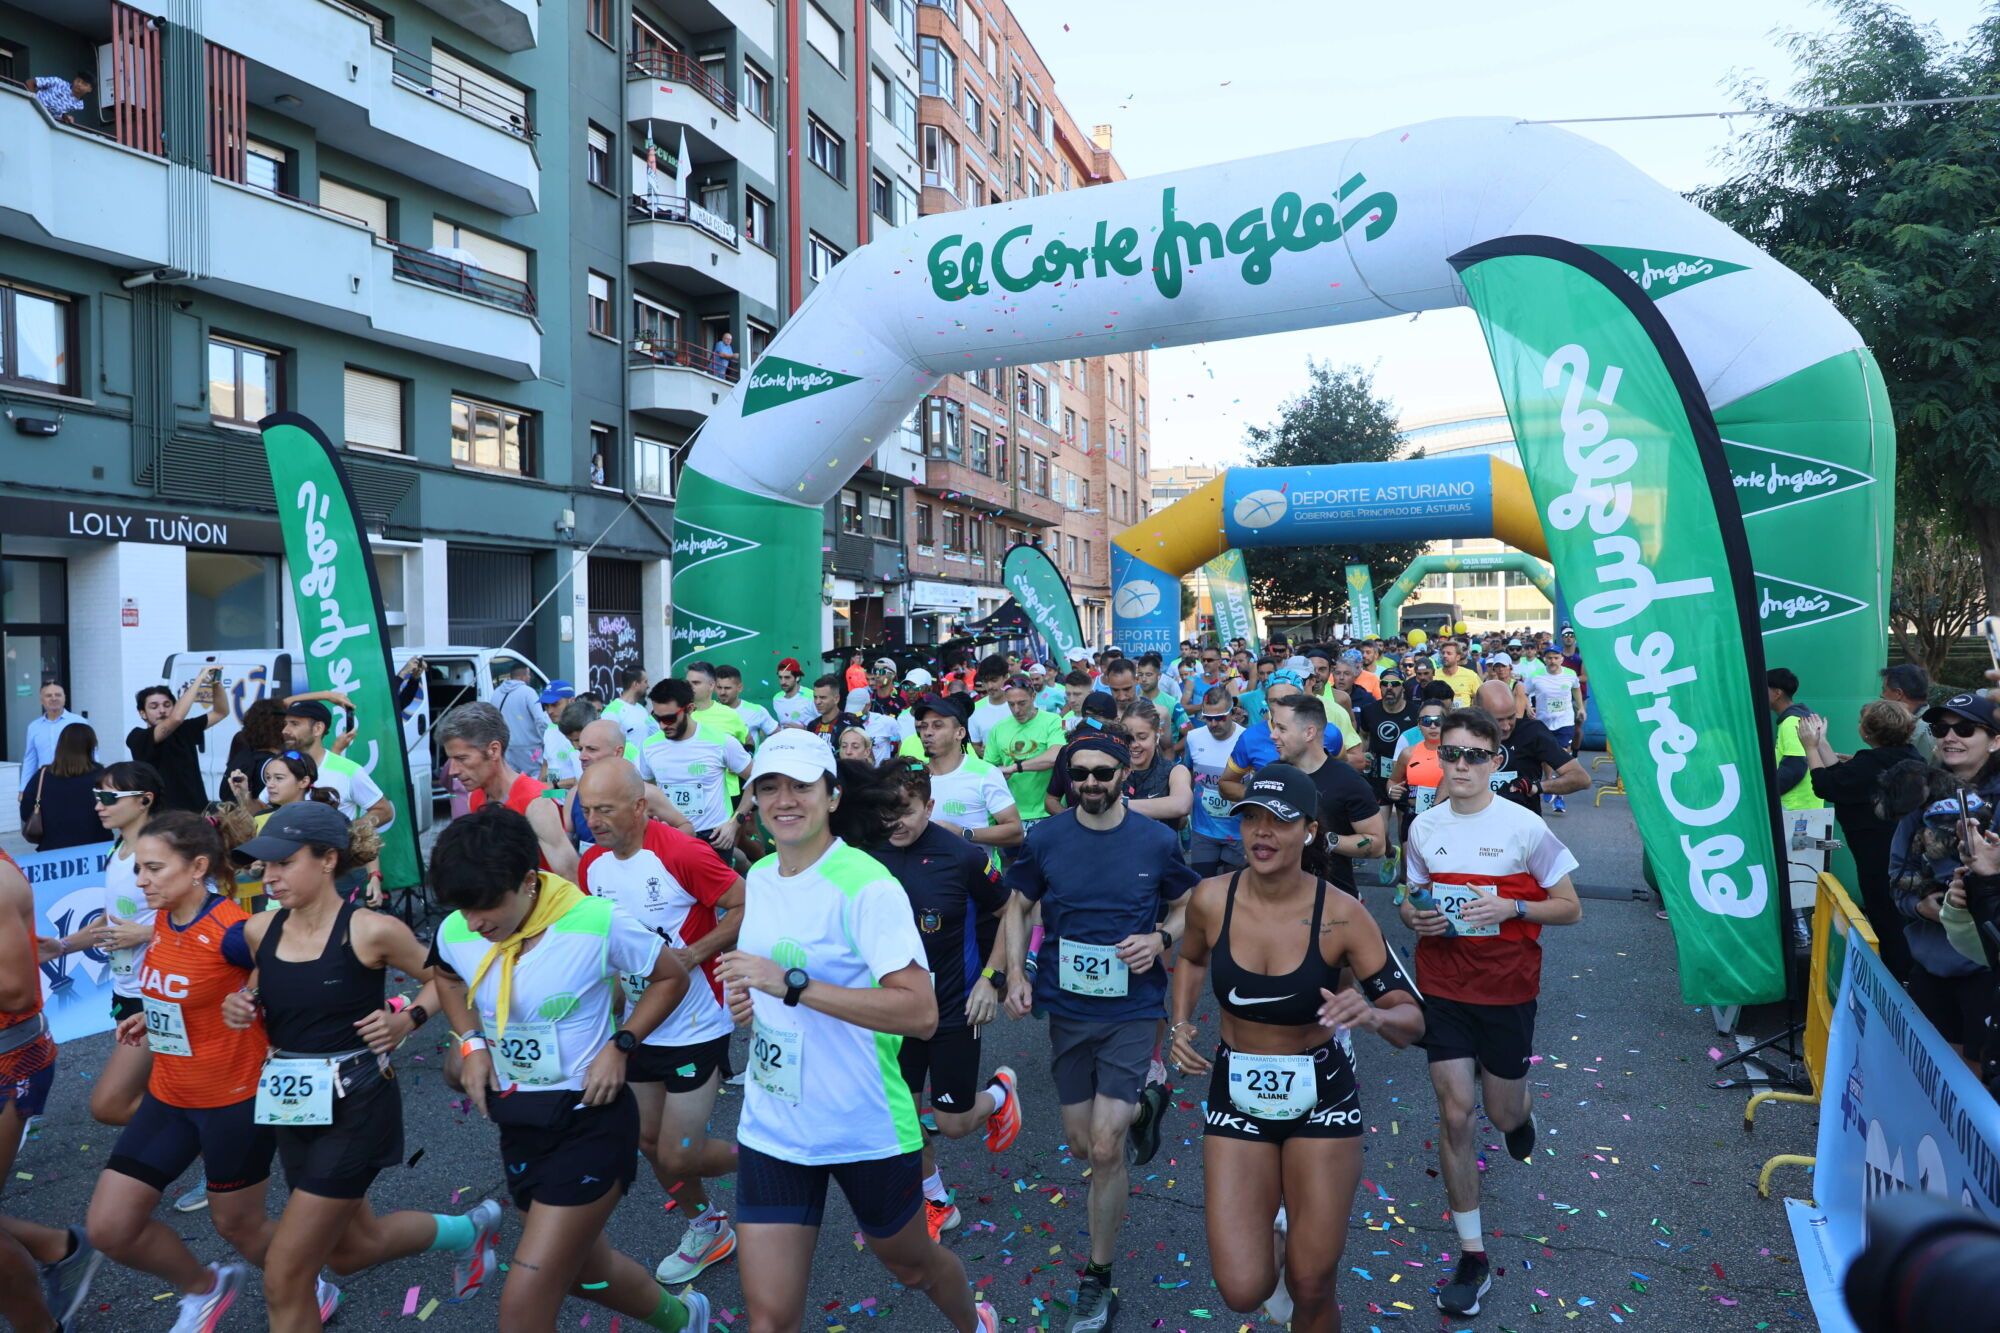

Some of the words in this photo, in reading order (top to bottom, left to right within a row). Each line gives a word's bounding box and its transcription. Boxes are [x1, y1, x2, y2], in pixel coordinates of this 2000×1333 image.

[927, 234, 989, 301] El
[991, 220, 1143, 293] Corte
[1153, 171, 1398, 299] Inglés
[1641, 258, 1713, 290] Inglés
[749, 375, 759, 389] El
[760, 373, 786, 388] Corte
[786, 367, 834, 392] Inglés
[1730, 470, 1766, 488] orte
[1767, 462, 1838, 495] Inglés
[1292, 488, 1370, 506] DEPORTE
[1376, 481, 1474, 501] ASTURIANO
[1294, 509, 1339, 521] GOBIERNO
[1341, 509, 1356, 519] DEL
[1357, 506, 1409, 518] PRINCIPADO
[1410, 506, 1422, 515] DE
[1425, 502, 1471, 514] ASTURIAS
[69, 511, 132, 538] LOLY
[145, 515, 227, 545] TUÑON
[689, 533, 728, 555] Inglés
[1760, 587, 1830, 619] Inglés
[688, 621, 727, 644] Inglés
[675, 791, 690, 802] 78
[1208, 796, 1227, 807] 500
[20, 857, 89, 884] ERDE
[1073, 955, 1109, 975] 521
[500, 1038, 542, 1061] 323
[1872, 972, 1908, 1056] MARATÓN
[1908, 1027, 1941, 1111] VERDE
[1939, 1079, 1957, 1139] DE
[270, 1074, 313, 1097] 325
[1246, 1069, 1296, 1092] 237
[1257, 1092, 1288, 1101] ALIANE
[1205, 1109, 1260, 1134] NIKE
